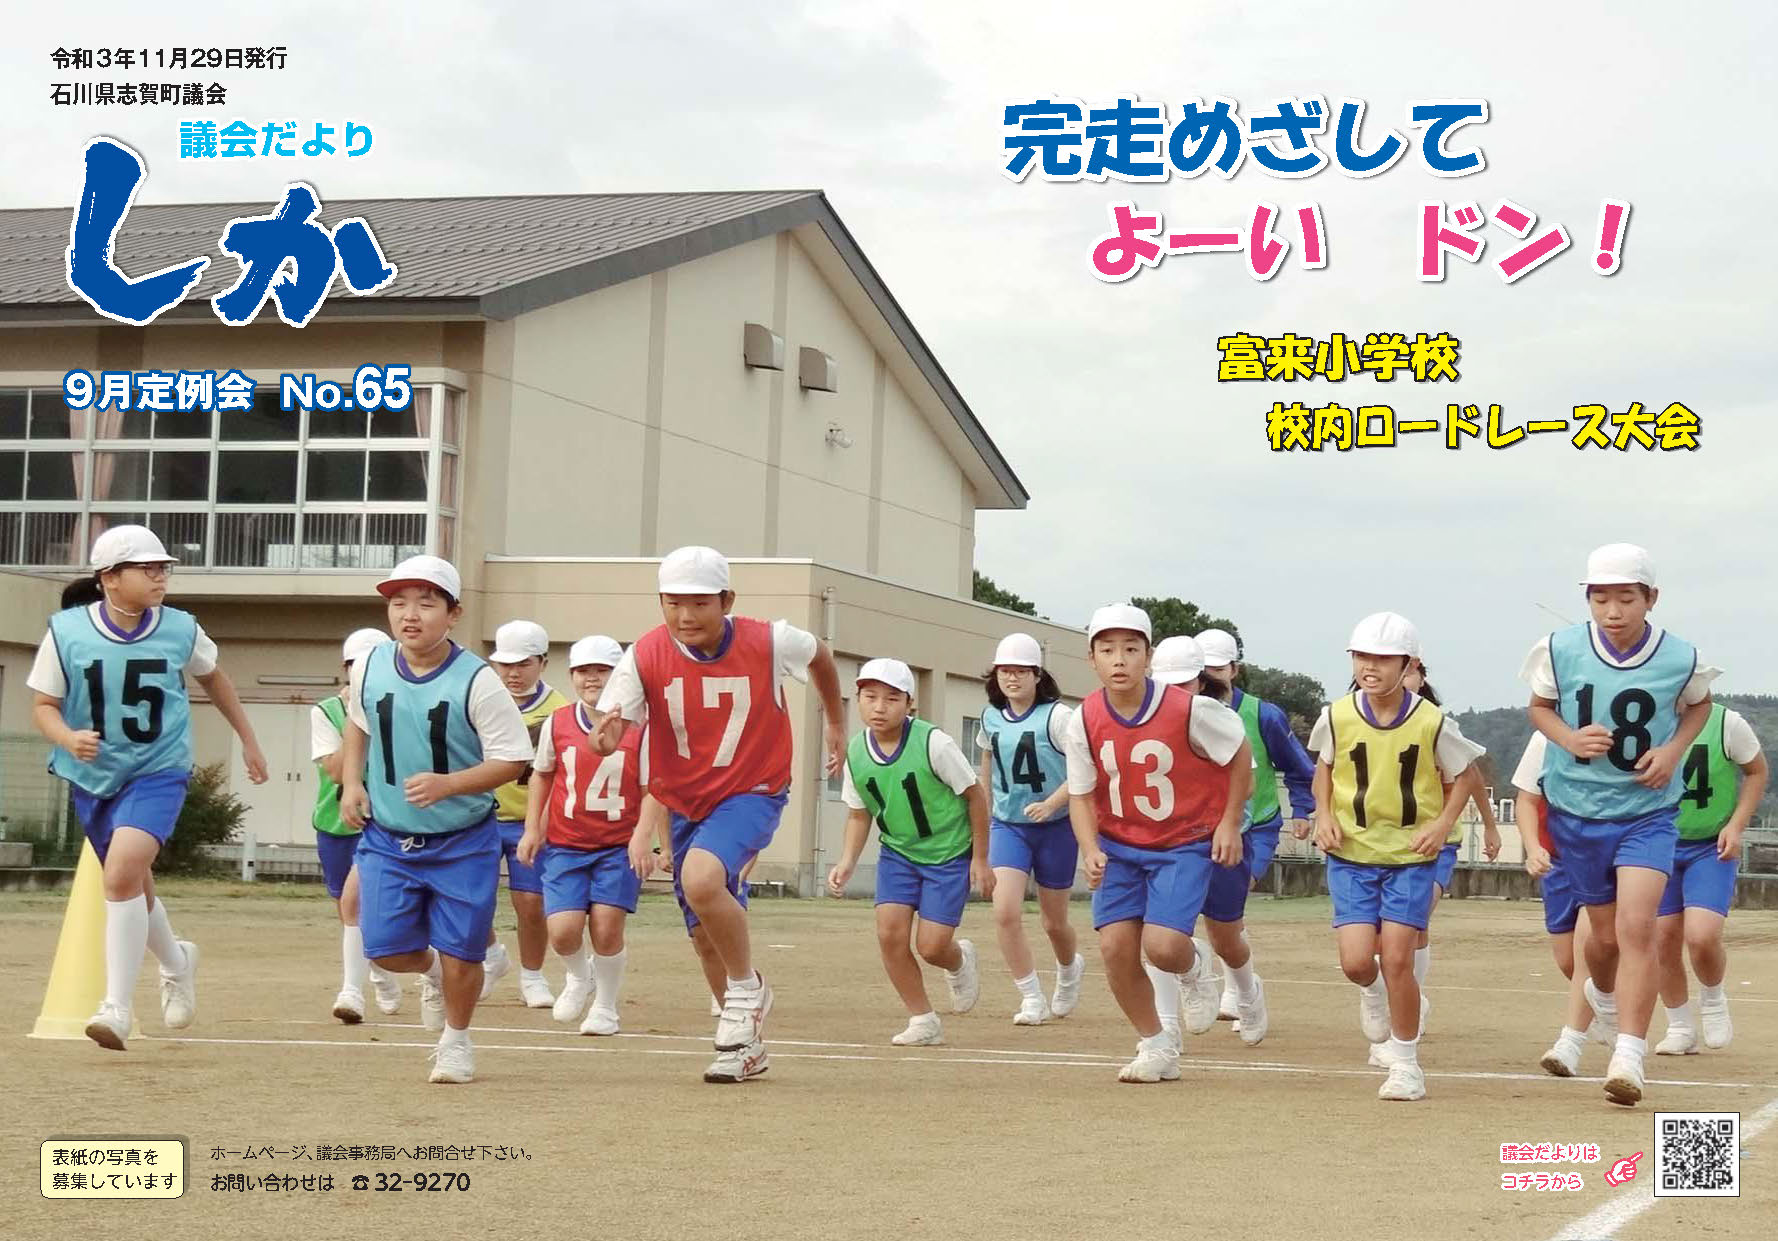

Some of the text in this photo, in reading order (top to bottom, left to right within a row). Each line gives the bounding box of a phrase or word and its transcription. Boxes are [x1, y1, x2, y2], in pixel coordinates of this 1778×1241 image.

[84, 658, 168, 744] 15
[376, 692, 450, 786] 11
[664, 676, 751, 768] 17
[1575, 683, 1656, 772] 18
[562, 745, 626, 822] 14
[865, 771, 932, 838] 11
[991, 731, 1046, 793] 14
[1100, 739, 1175, 822] 13
[1349, 742, 1419, 828] 11
